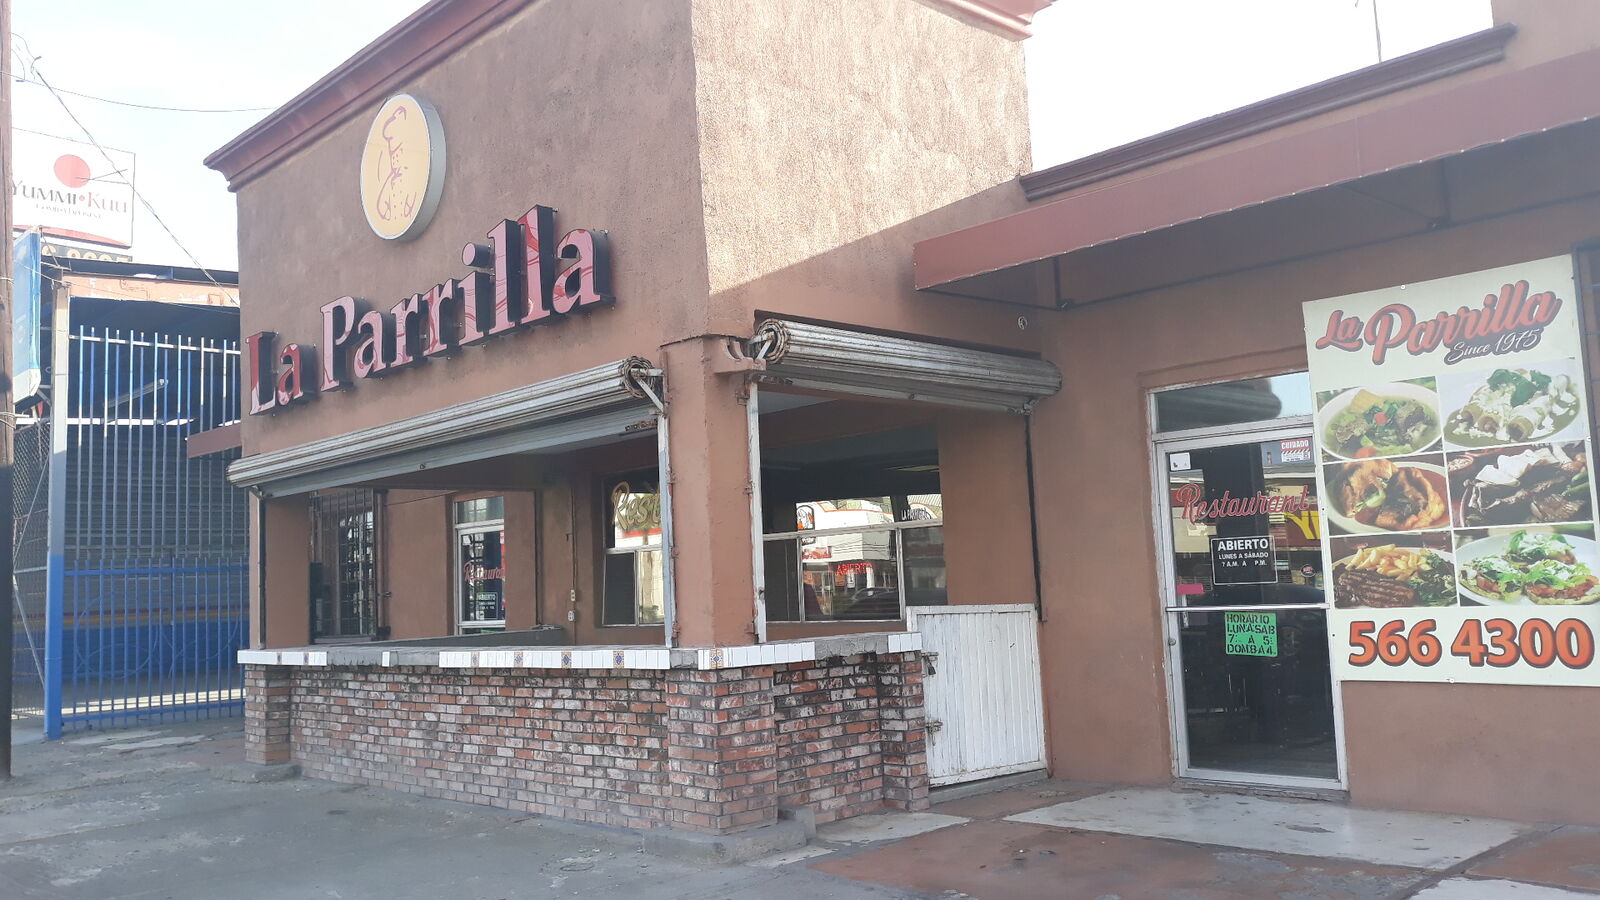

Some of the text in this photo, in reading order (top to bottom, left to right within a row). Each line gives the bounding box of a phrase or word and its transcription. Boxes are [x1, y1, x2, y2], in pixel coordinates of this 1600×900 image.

[246, 204, 608, 415] La Parrilla
[1315, 279, 1563, 366] La Parrilla
[1446, 328, 1540, 363] Since 1975
[1177, 484, 1310, 525] Restaurant
[1217, 538, 1269, 552] ABIERTO
[1226, 614, 1270, 624] HORARIO
[1248, 634, 1255, 644] A
[1348, 617, 1595, 670] 566 4300
